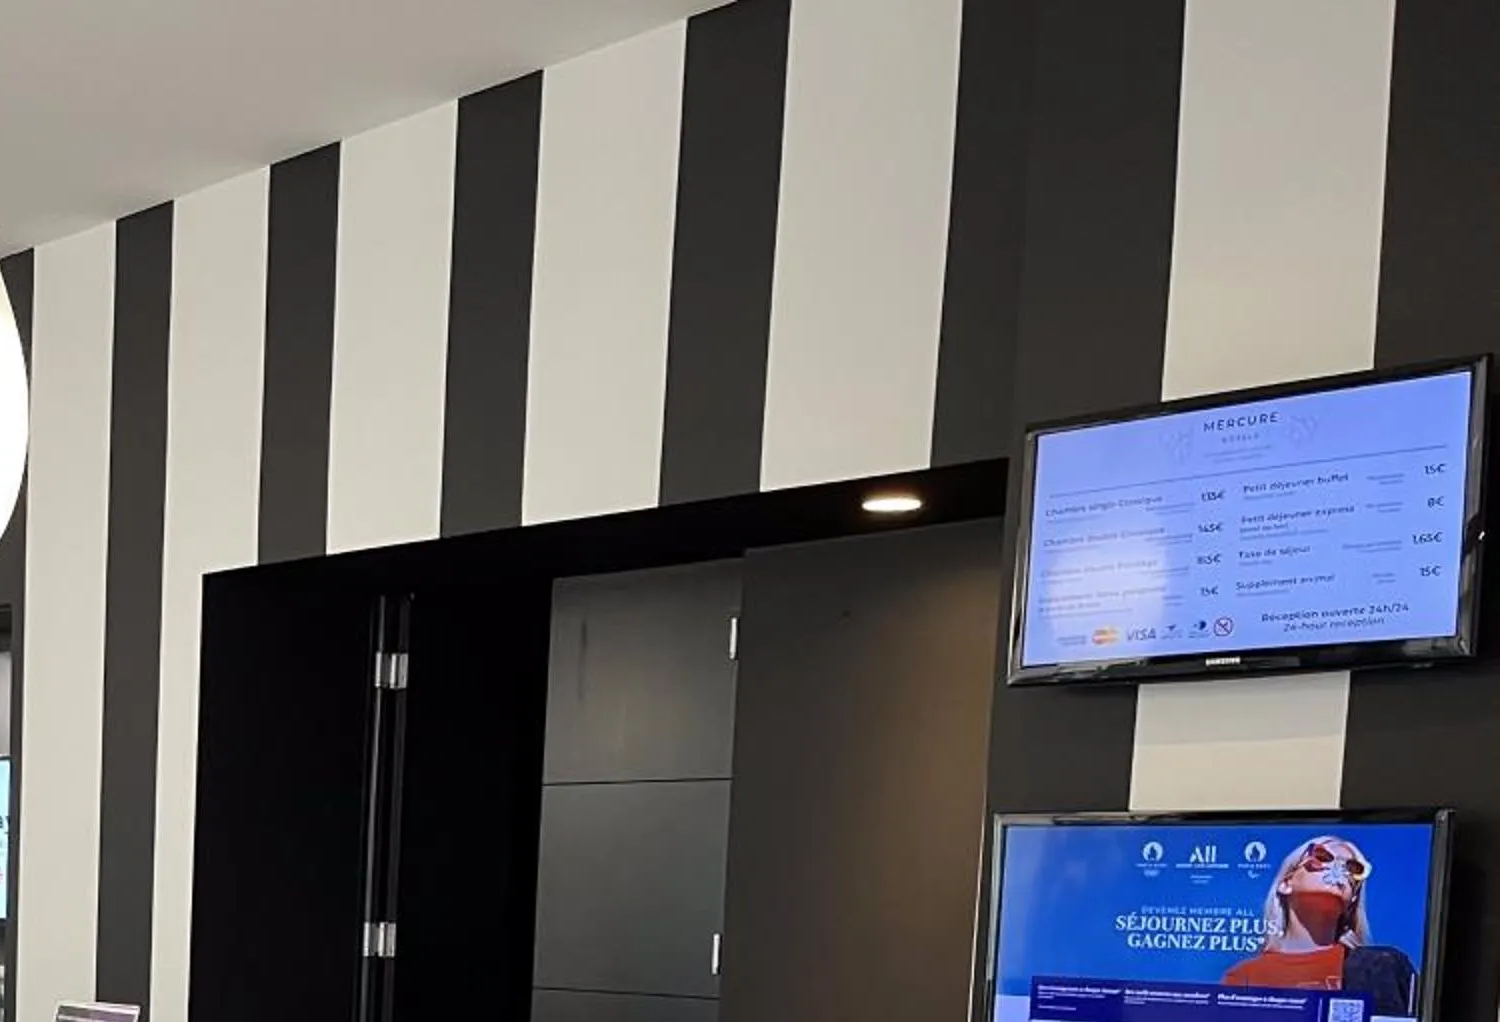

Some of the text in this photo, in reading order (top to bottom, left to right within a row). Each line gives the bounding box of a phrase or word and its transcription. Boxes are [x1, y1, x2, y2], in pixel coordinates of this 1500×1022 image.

[1203, 412, 1280, 432] MERCURE
[1424, 463, 1447, 475] 15€
[1127, 627, 1157, 641] VISA
[1235, 907, 1255, 917] ALL
[1115, 912, 1285, 937] SÉJOURNEZ PLUS,
[1127, 932, 1205, 950] GAGNEZ
